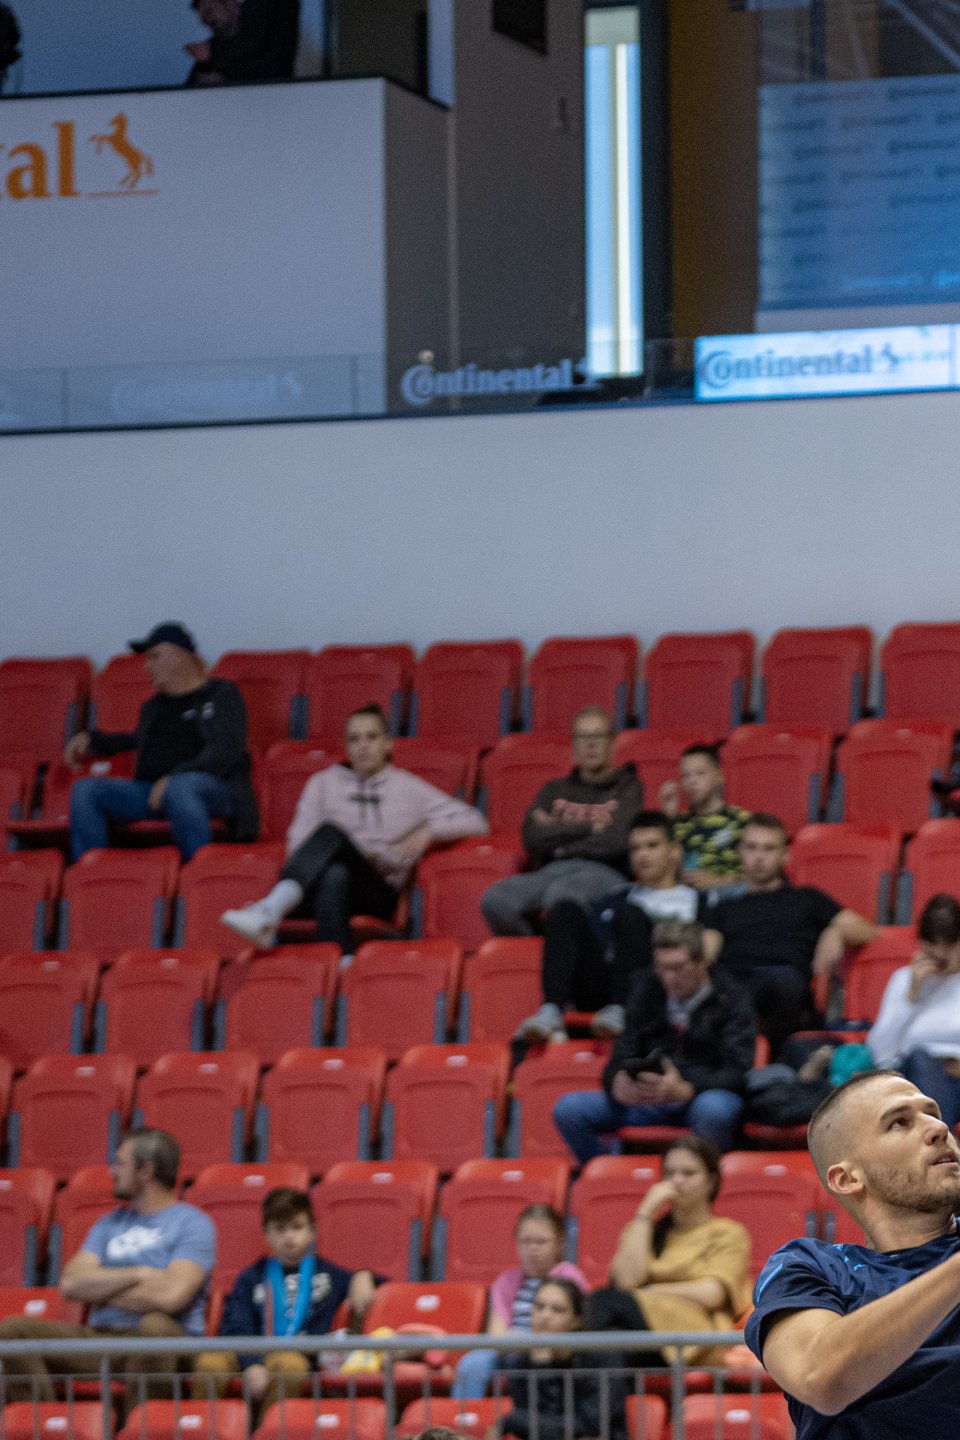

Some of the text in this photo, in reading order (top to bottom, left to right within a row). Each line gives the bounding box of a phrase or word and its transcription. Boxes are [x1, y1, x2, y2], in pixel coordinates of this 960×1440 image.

[0, 120, 80, 199] al
[401, 358, 573, 407] Continental
[701, 343, 872, 389] Continental
